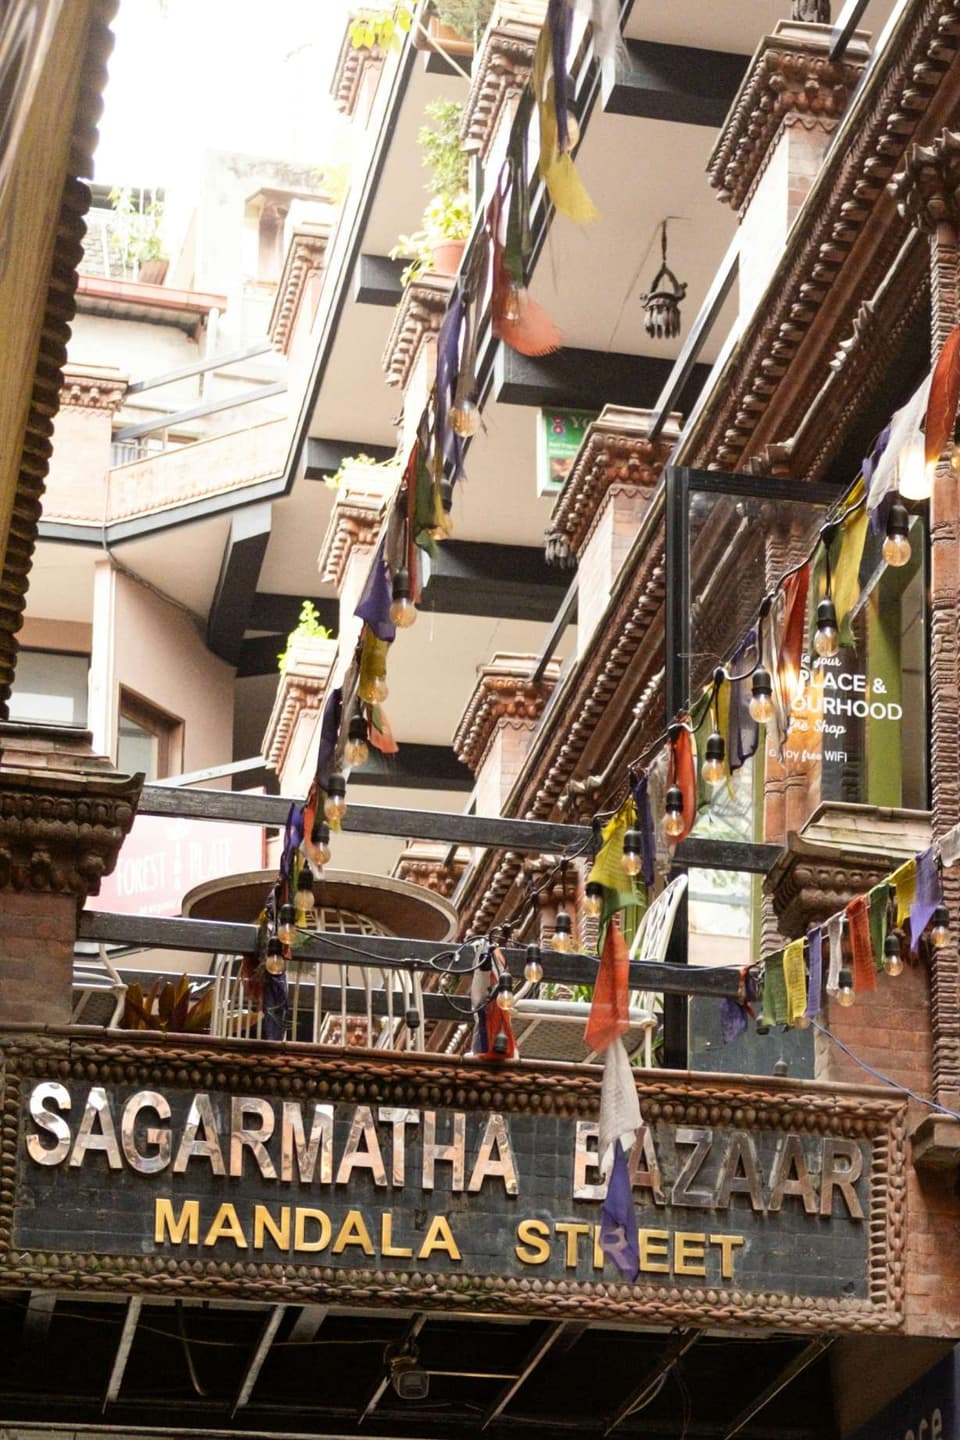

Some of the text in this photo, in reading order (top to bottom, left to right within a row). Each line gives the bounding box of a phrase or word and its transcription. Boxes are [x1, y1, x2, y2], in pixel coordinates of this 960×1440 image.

[799, 669, 887, 695] PLACE &
[790, 696, 903, 721] OURHOOD
[815, 719, 847, 739] Shop
[26, 1081, 864, 1219] SAGARMATHA BAZAAR
[154, 1197, 745, 1279] MANDALA STREET
